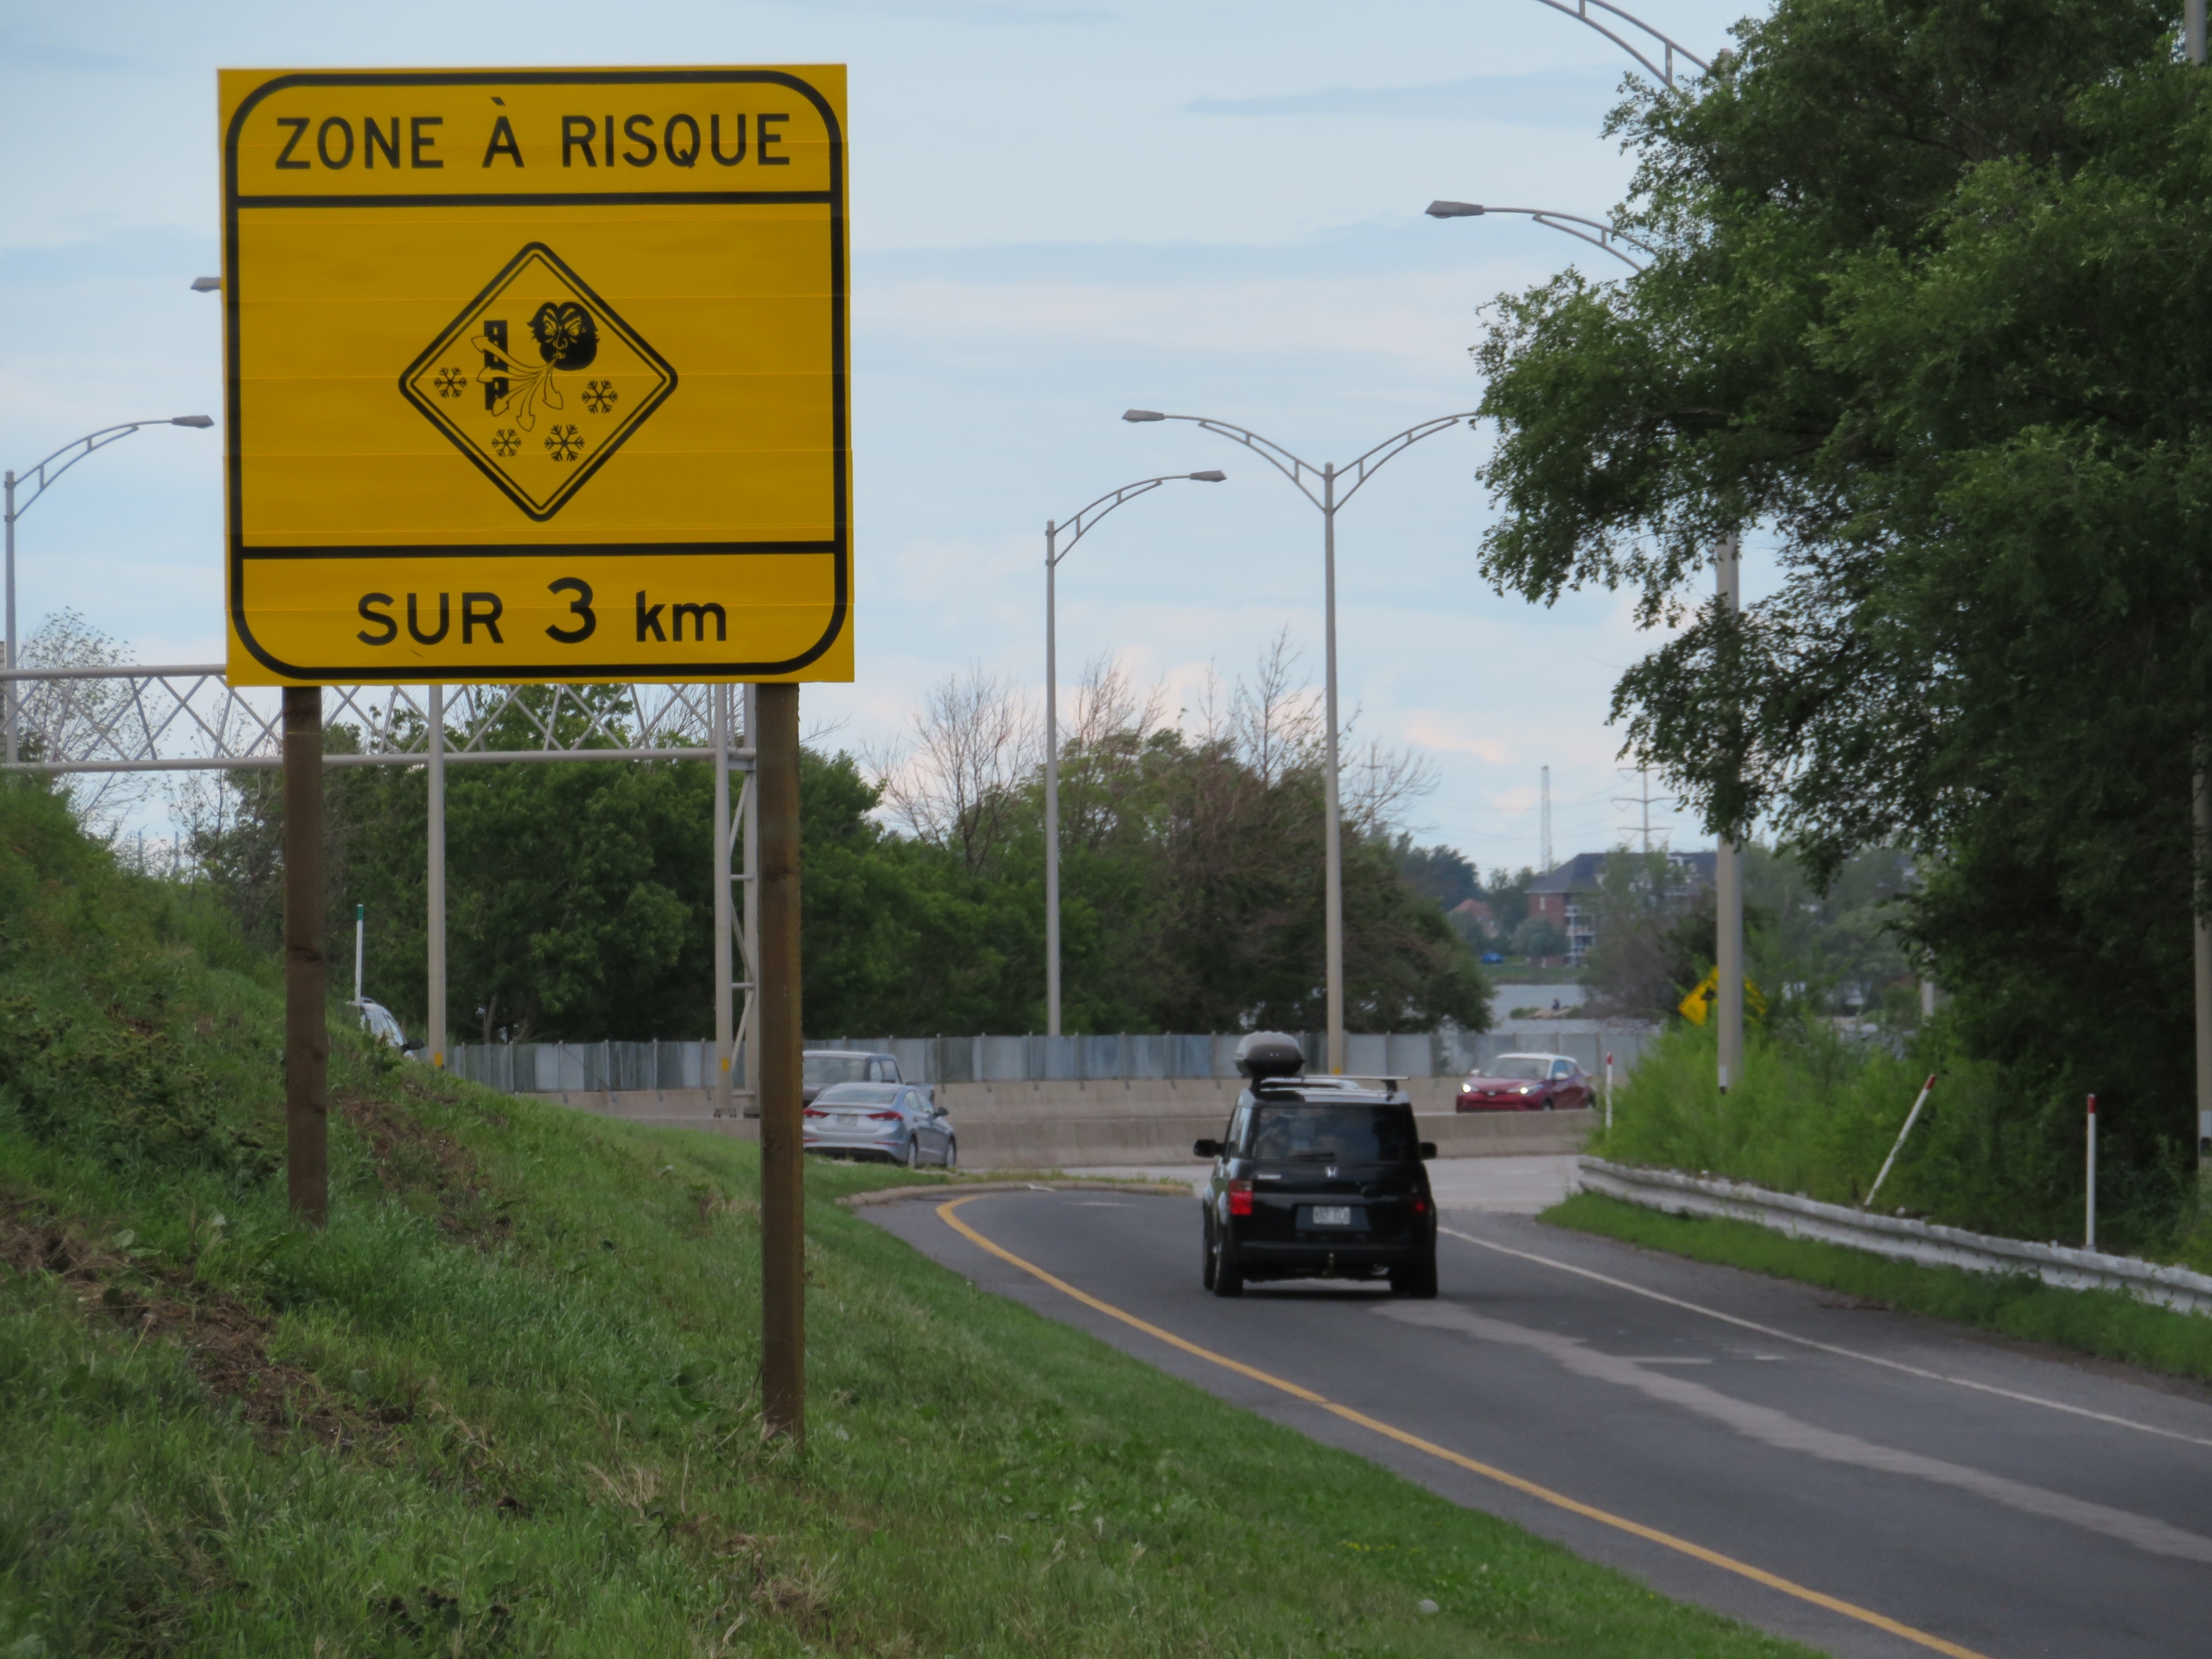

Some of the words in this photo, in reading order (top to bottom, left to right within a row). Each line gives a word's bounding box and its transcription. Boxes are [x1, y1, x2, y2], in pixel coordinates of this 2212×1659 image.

[275, 116, 444, 170] ZONE
[481, 97, 524, 168] À
[562, 113, 791, 169] RISQUE
[357, 592, 505, 646] SUR
[544, 576, 597, 644] 3
[635, 590, 727, 642] km
